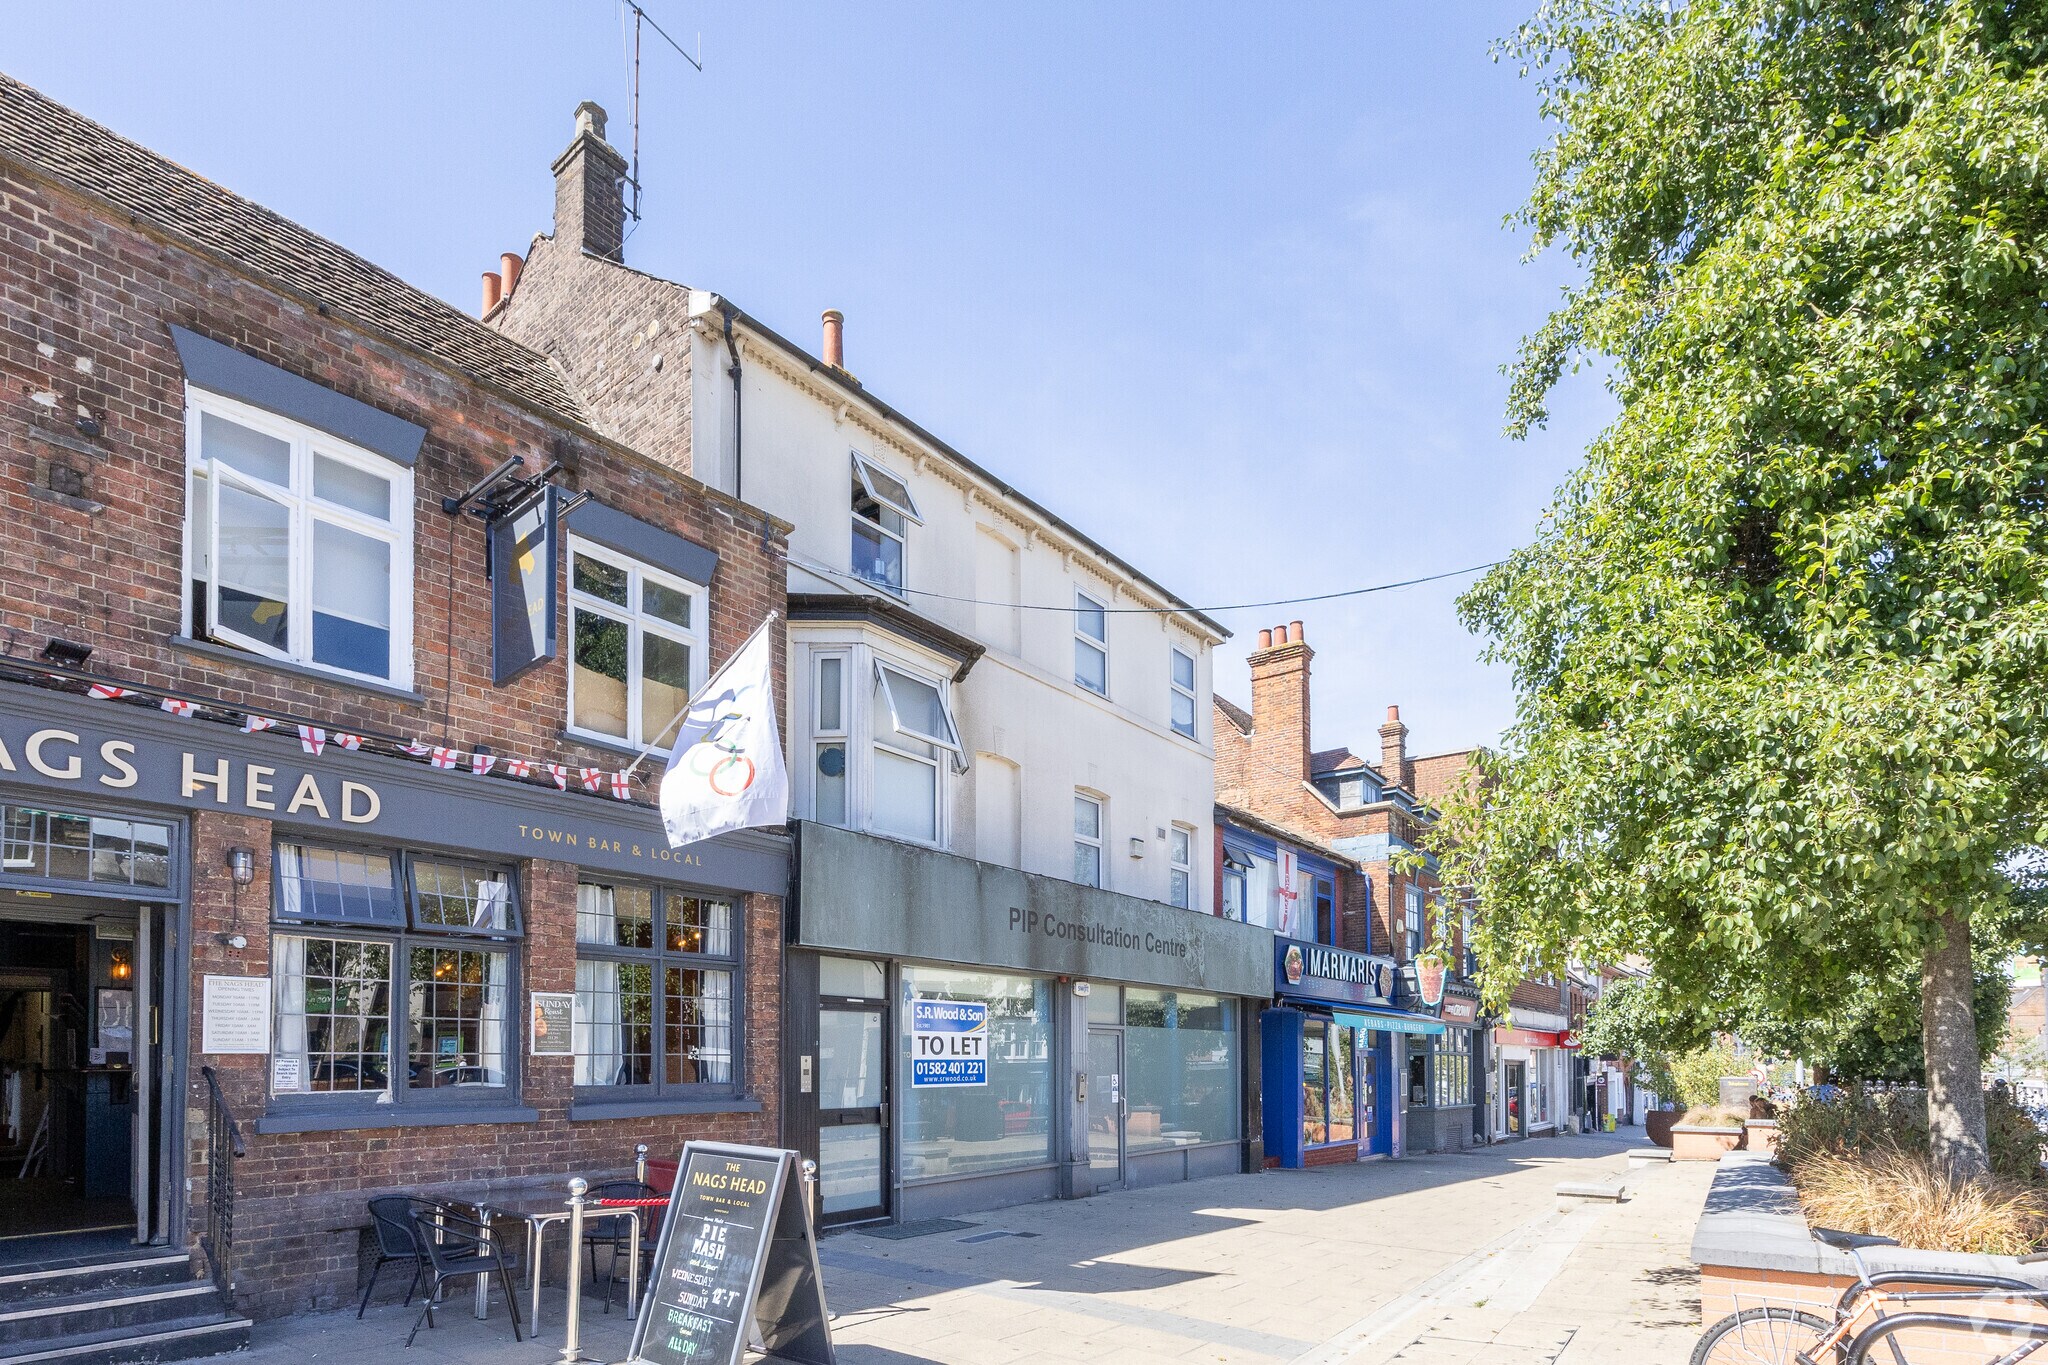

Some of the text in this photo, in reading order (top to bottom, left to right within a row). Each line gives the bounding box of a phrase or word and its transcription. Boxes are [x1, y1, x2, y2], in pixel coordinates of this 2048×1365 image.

[181, 752, 381, 824] HEAD
[518, 825, 702, 866] TOWN BAR & LOCAL
[1009, 906, 1186, 958] PIP Consultation Centre
[1310, 948, 1377, 985] MARMARIS
[537, 1000, 571, 1008] SUNDAY
[960, 1008, 967, 1020] &
[967, 1009, 983, 1021] Son
[1404, 1023, 1424, 1032] BURGERS
[918, 1036, 982, 1055] TO LET
[916, 1062, 982, 1074] 01582 401 221
[726, 1162, 740, 1172] THE
[692, 1172, 766, 1194] NAGS HEAD
[700, 1224, 728, 1242] PIE
[691, 1238, 726, 1260] MASH
[672, 1268, 714, 1288] WEDNESDAY
[678, 1292, 708, 1310] SUNDAY
[668, 1308, 714, 1333] BREAKFAST
[668, 1336, 698, 1356] ALL DAY
